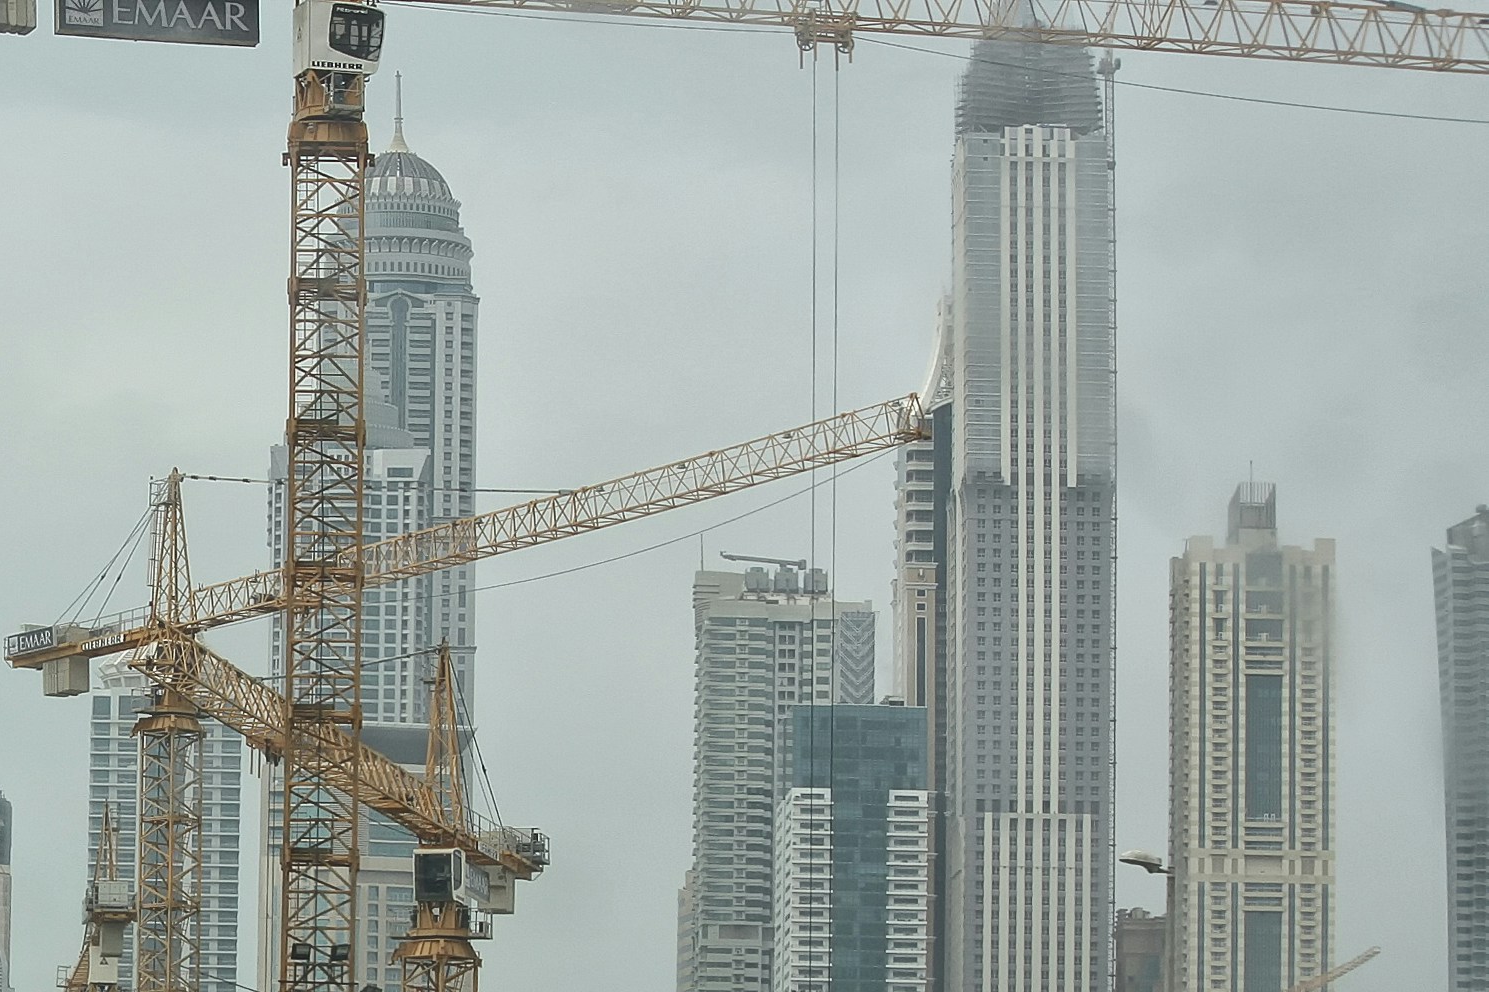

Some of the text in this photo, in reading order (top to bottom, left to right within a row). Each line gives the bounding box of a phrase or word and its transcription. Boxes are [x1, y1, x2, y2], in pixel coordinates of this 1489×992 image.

[68, 15, 100, 25] EMAAR
[112, 0, 250, 32] EMAAR
[311, 60, 363, 70] LIEBHERR
[19, 630, 52, 651] EMAAR
